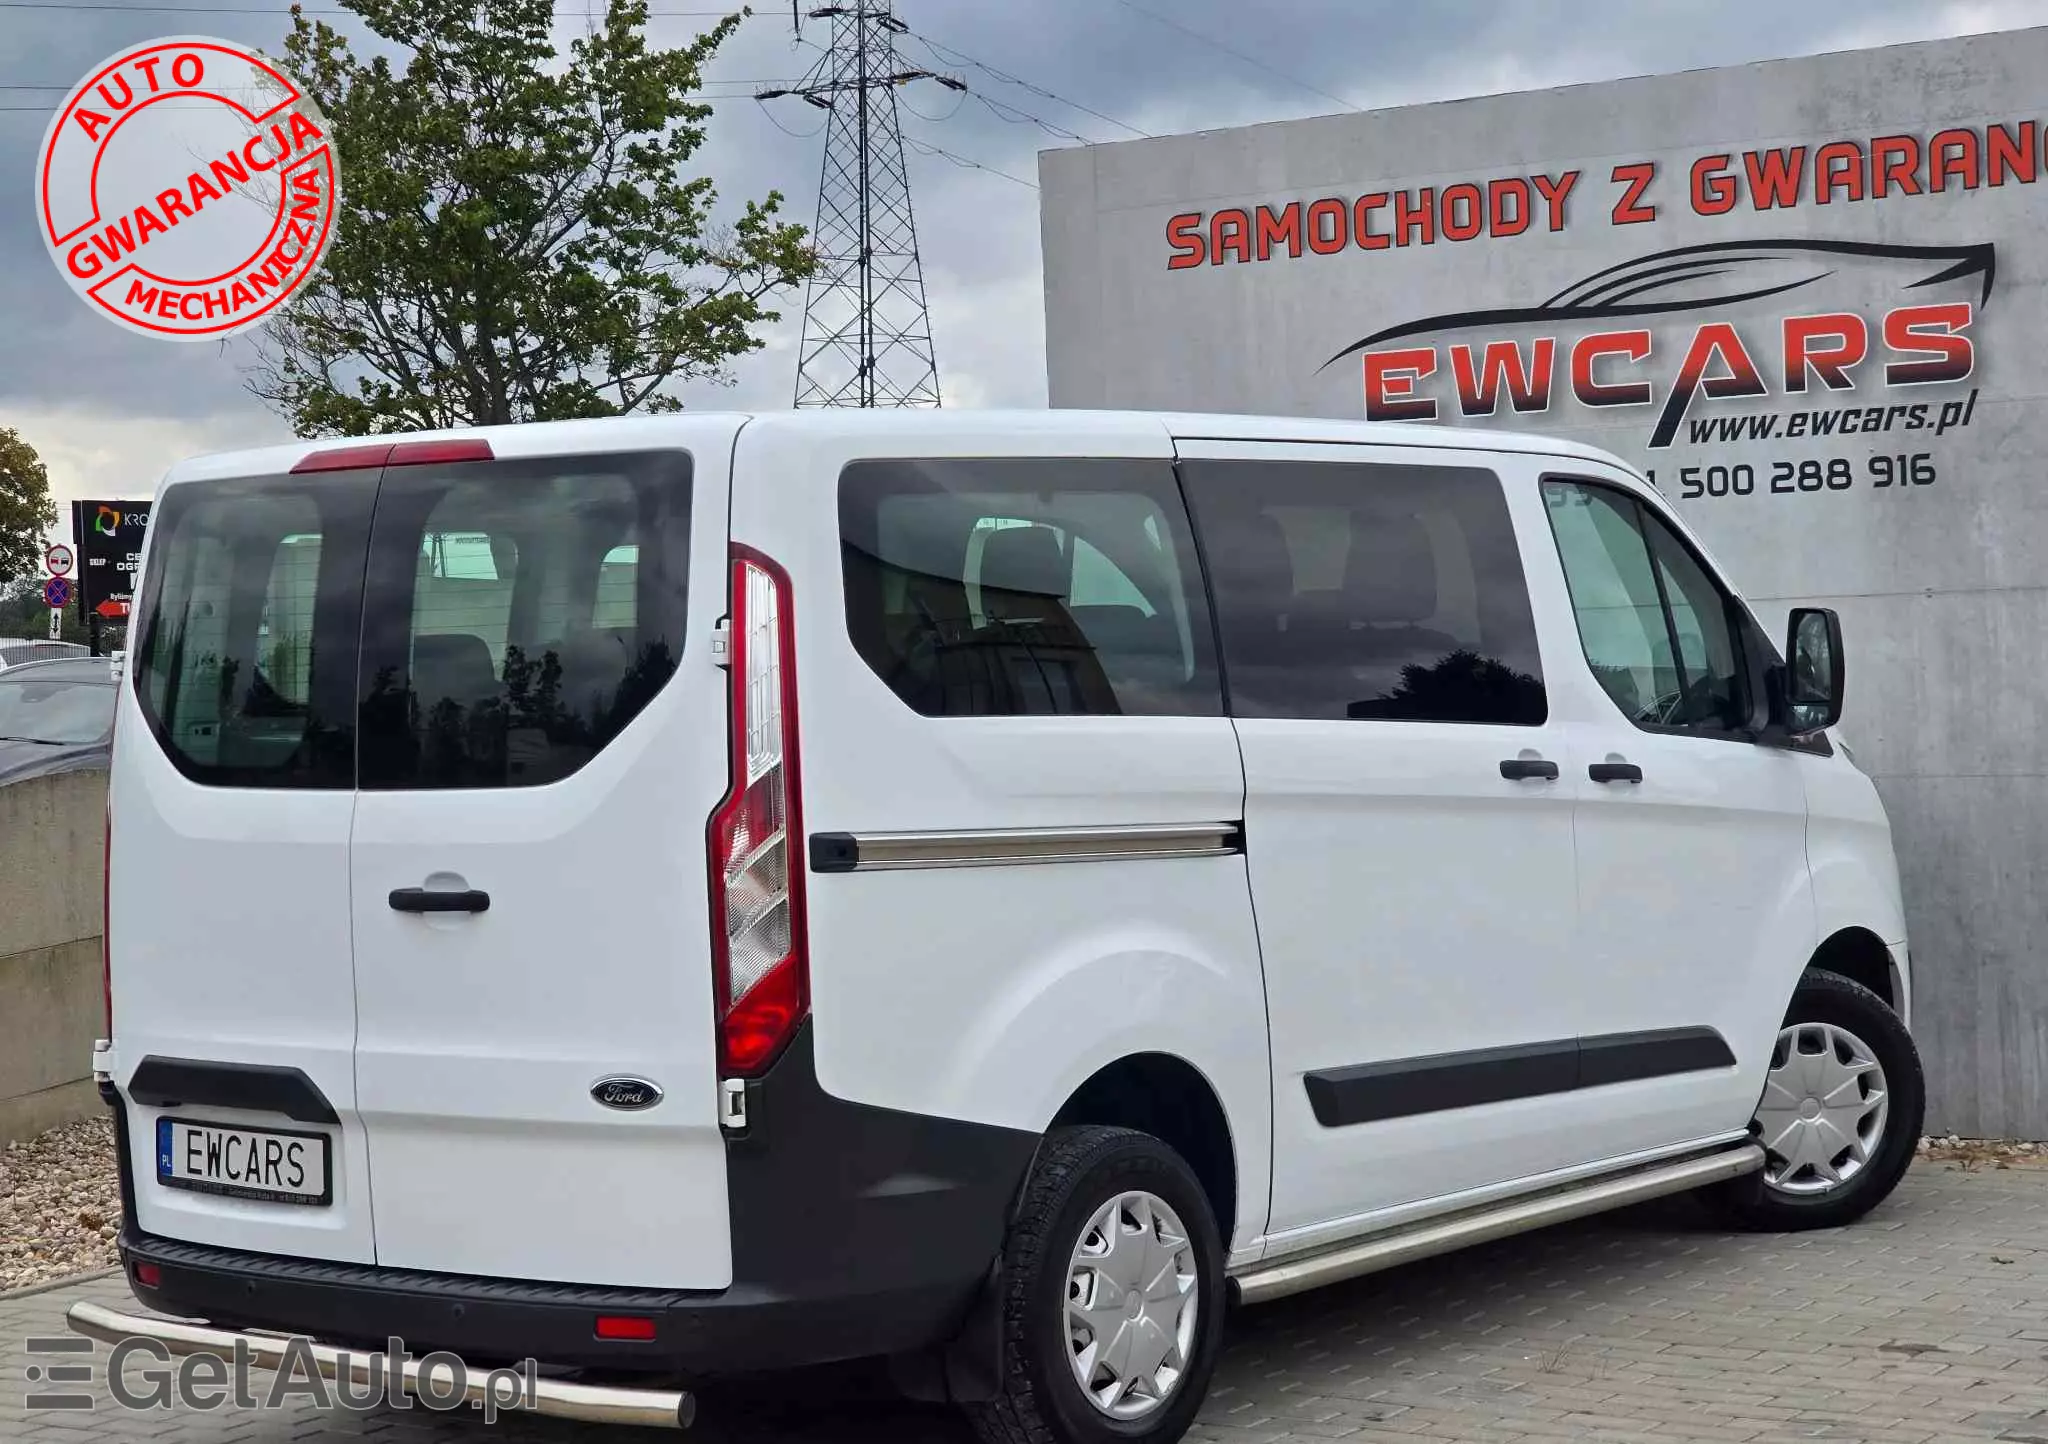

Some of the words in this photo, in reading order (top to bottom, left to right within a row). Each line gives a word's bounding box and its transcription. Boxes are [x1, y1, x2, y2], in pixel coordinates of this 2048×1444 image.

[1166, 170, 1581, 270] SAMOCHODY
[1611, 162, 1656, 226] Z
[1689, 119, 2048, 217] GWARAN
[1362, 302, 1975, 449] EWCARS
[1689, 389, 1979, 444] www.ewcars.pl
[1680, 464, 1754, 499] 500
[1770, 459, 1852, 493] 288
[1868, 453, 1936, 488] 916
[604, 1083, 645, 1102] Ford
[187, 1129, 305, 1187] EWCARS
